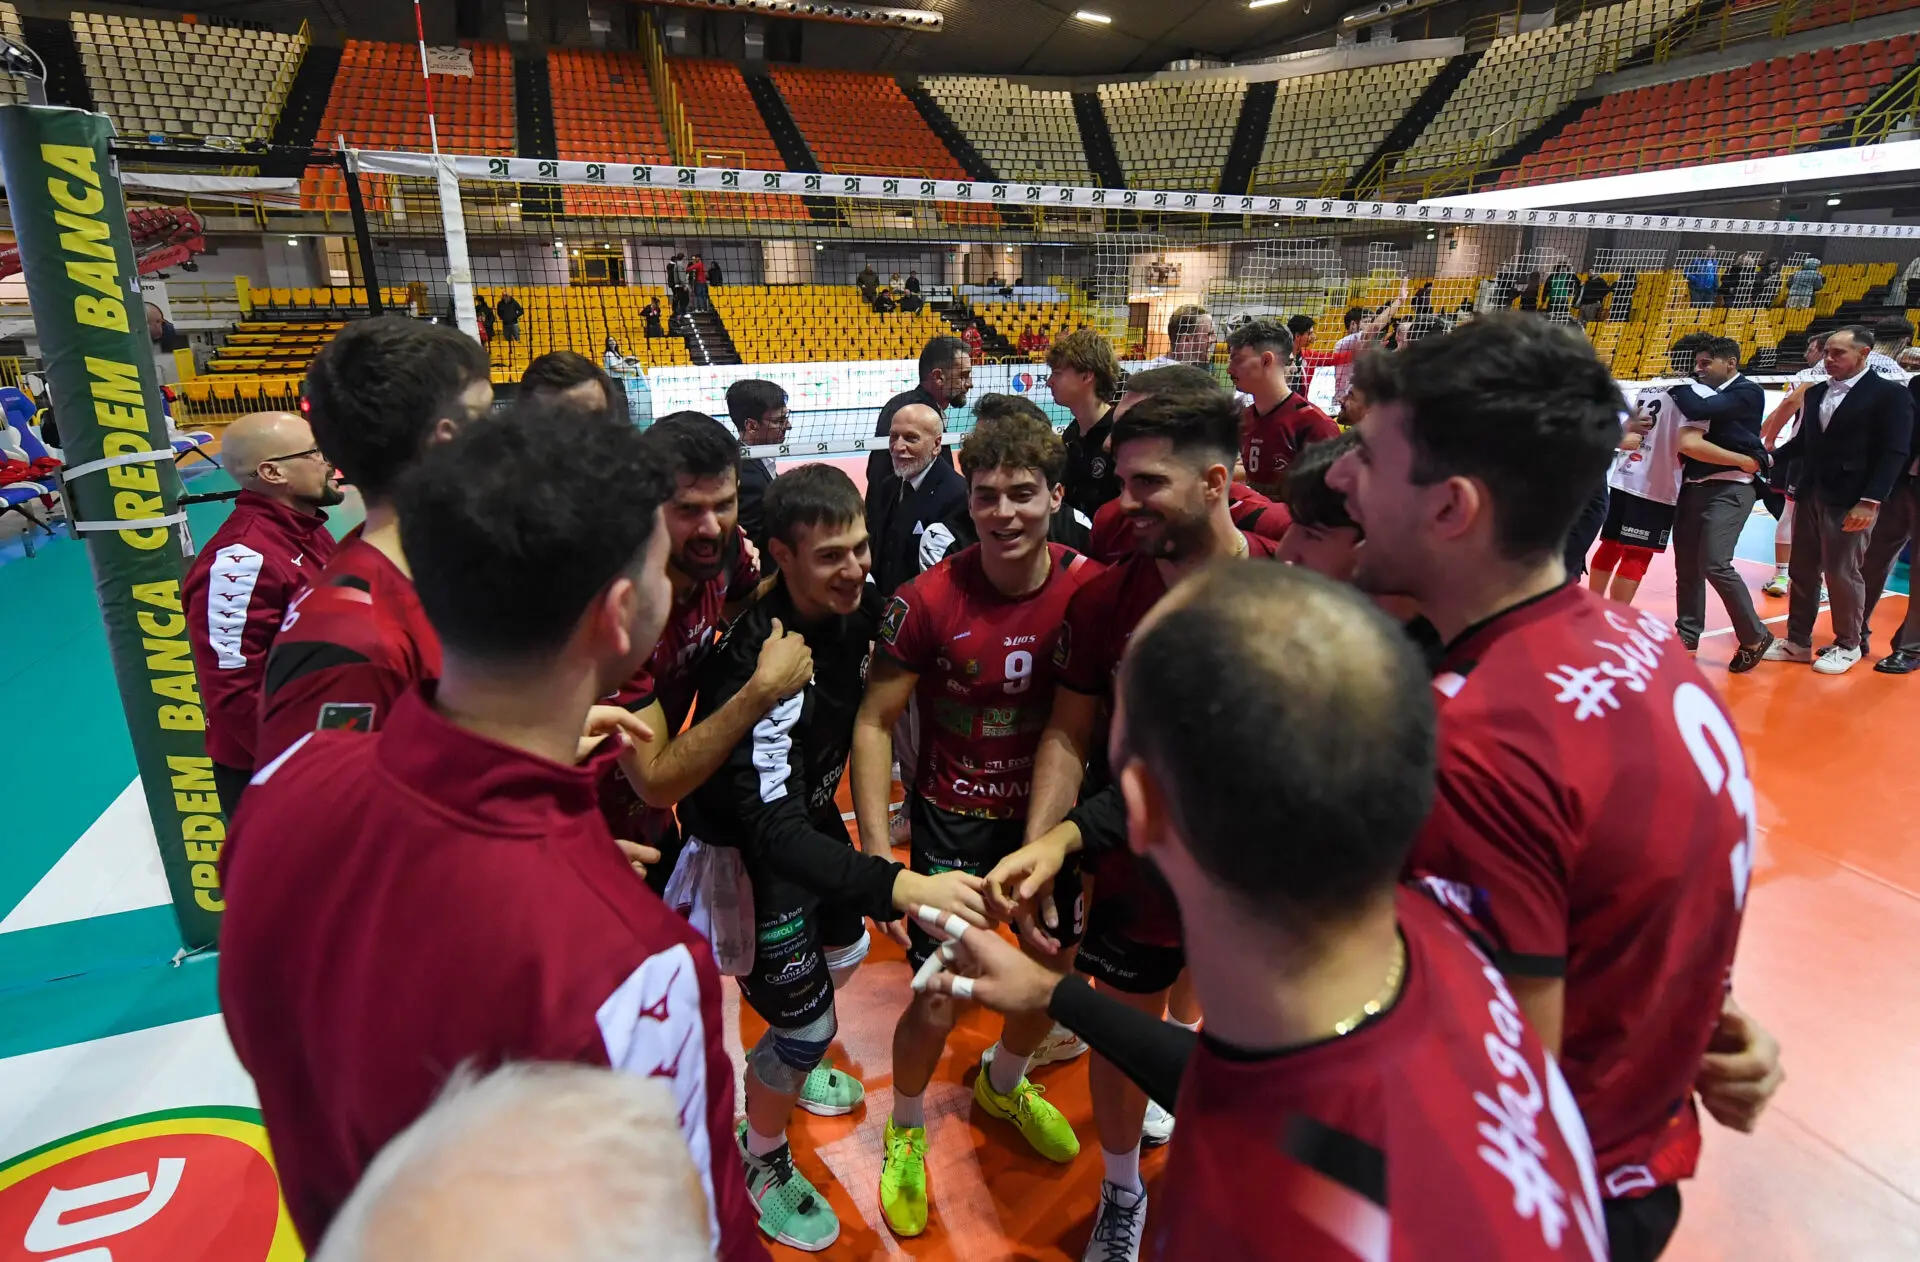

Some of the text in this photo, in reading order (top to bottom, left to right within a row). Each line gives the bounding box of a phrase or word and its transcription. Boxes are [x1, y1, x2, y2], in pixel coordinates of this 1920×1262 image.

[41, 144, 130, 334] BANCA
[84, 356, 169, 550] CREDEM
[1249, 446, 1260, 472] 6
[1003, 651, 1033, 694] 9
[132, 579, 227, 912] CREDEM BANCA
[1073, 892, 1084, 934] 9
[764, 951, 818, 983] Cannizzaro
